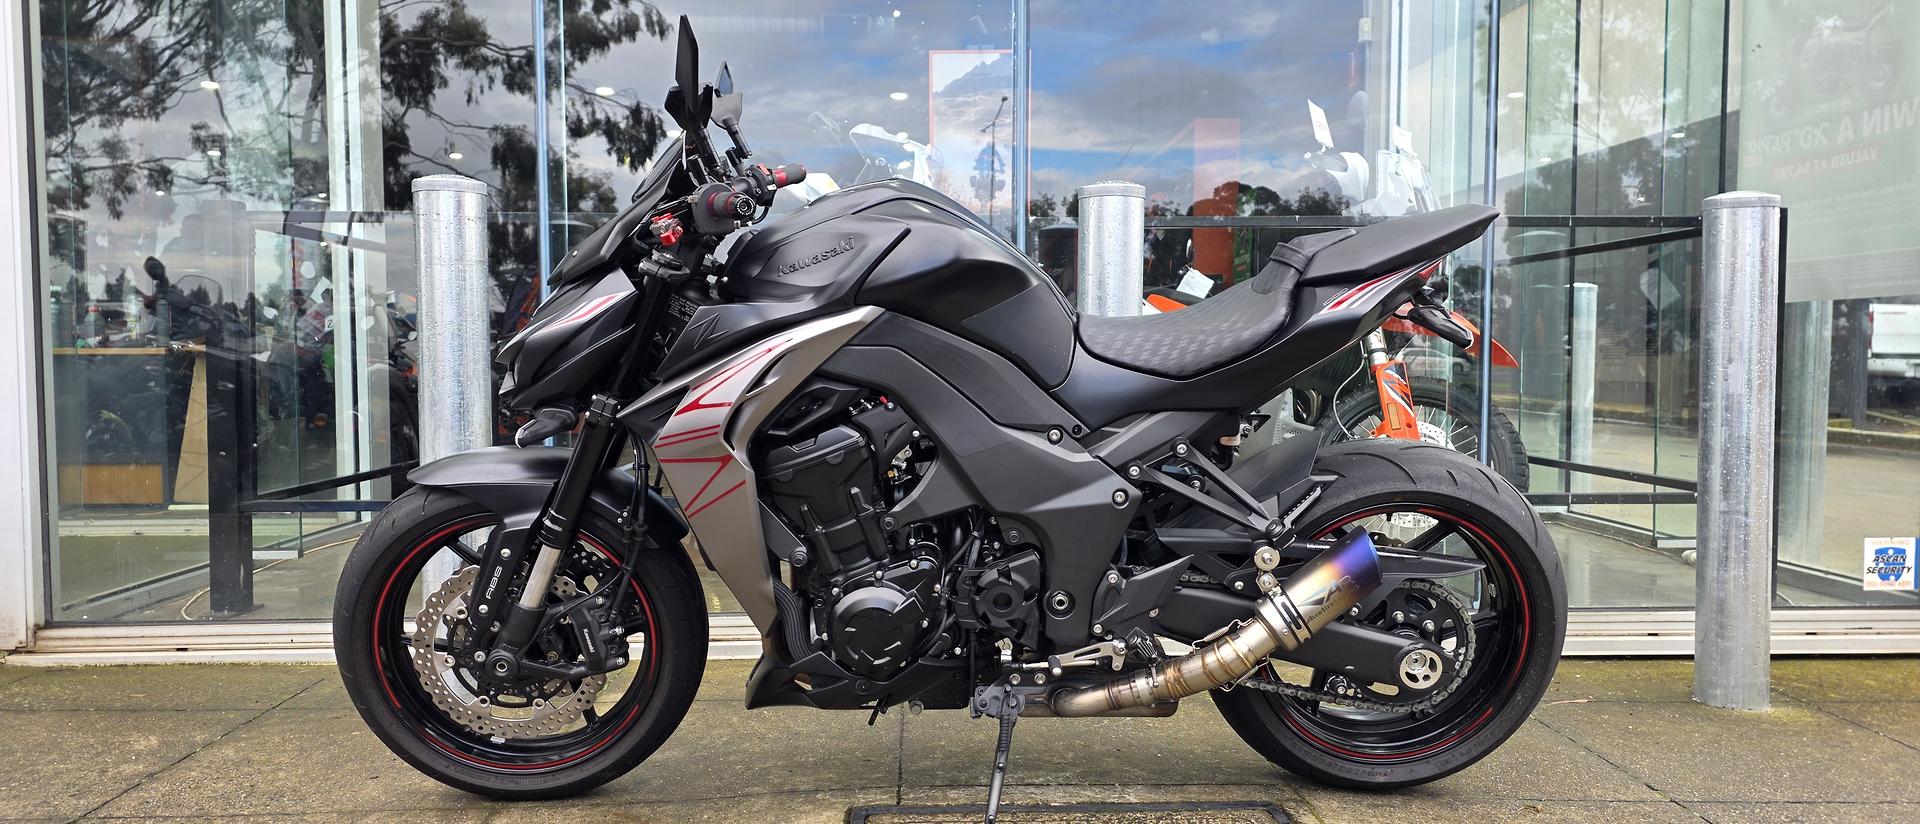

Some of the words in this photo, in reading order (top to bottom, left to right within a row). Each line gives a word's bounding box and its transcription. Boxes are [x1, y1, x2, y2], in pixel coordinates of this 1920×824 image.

[776, 236, 855, 277] Kawasaki
[1323, 288, 1348, 306] 1000
[1872, 555, 1907, 563] ASCAN
[1866, 566, 1912, 574] SECURITY
[486, 565, 502, 600] ABS
